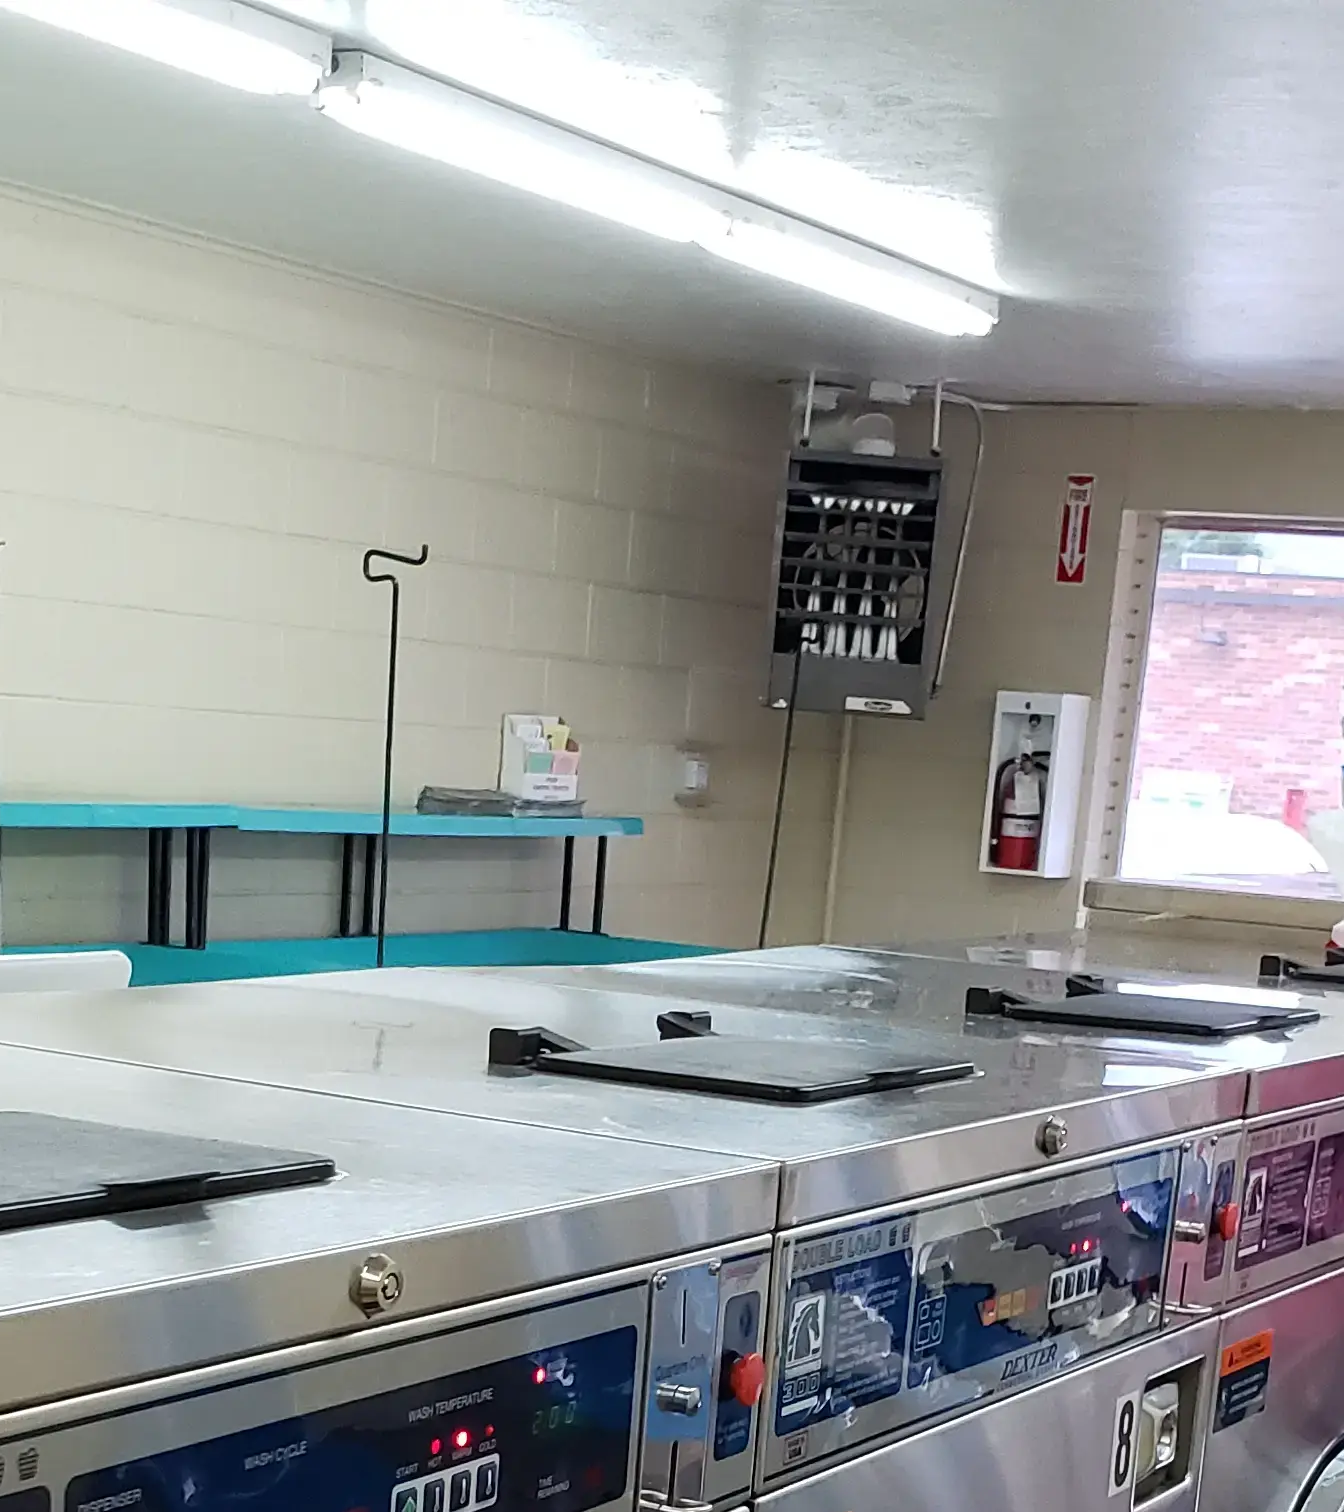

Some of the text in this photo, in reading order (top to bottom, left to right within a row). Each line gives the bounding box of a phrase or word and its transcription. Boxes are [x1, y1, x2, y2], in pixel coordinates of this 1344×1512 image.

[1001, 1344, 1058, 1381] DEXTER
[783, 1374, 820, 1403] 300
[1114, 1400, 1134, 1487] 8
